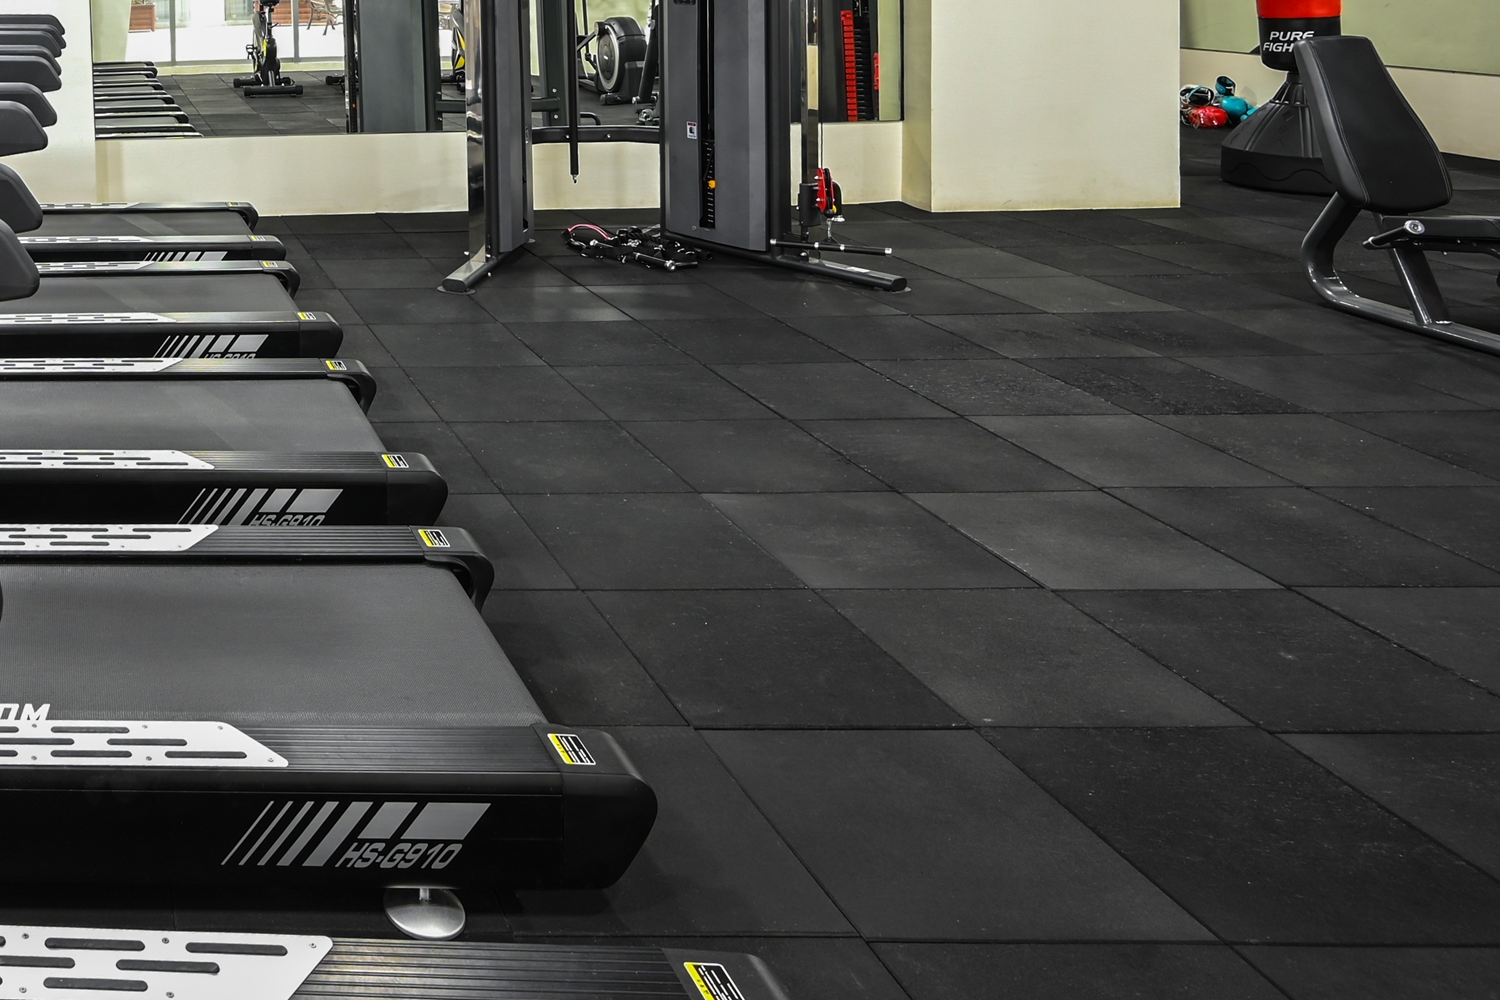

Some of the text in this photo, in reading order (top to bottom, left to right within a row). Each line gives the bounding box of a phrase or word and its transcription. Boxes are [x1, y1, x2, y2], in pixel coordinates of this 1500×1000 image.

[1269, 31, 1315, 41] PURE
[1263, 42, 1295, 52] FIGH
[335, 842, 463, 869] HS-G910
